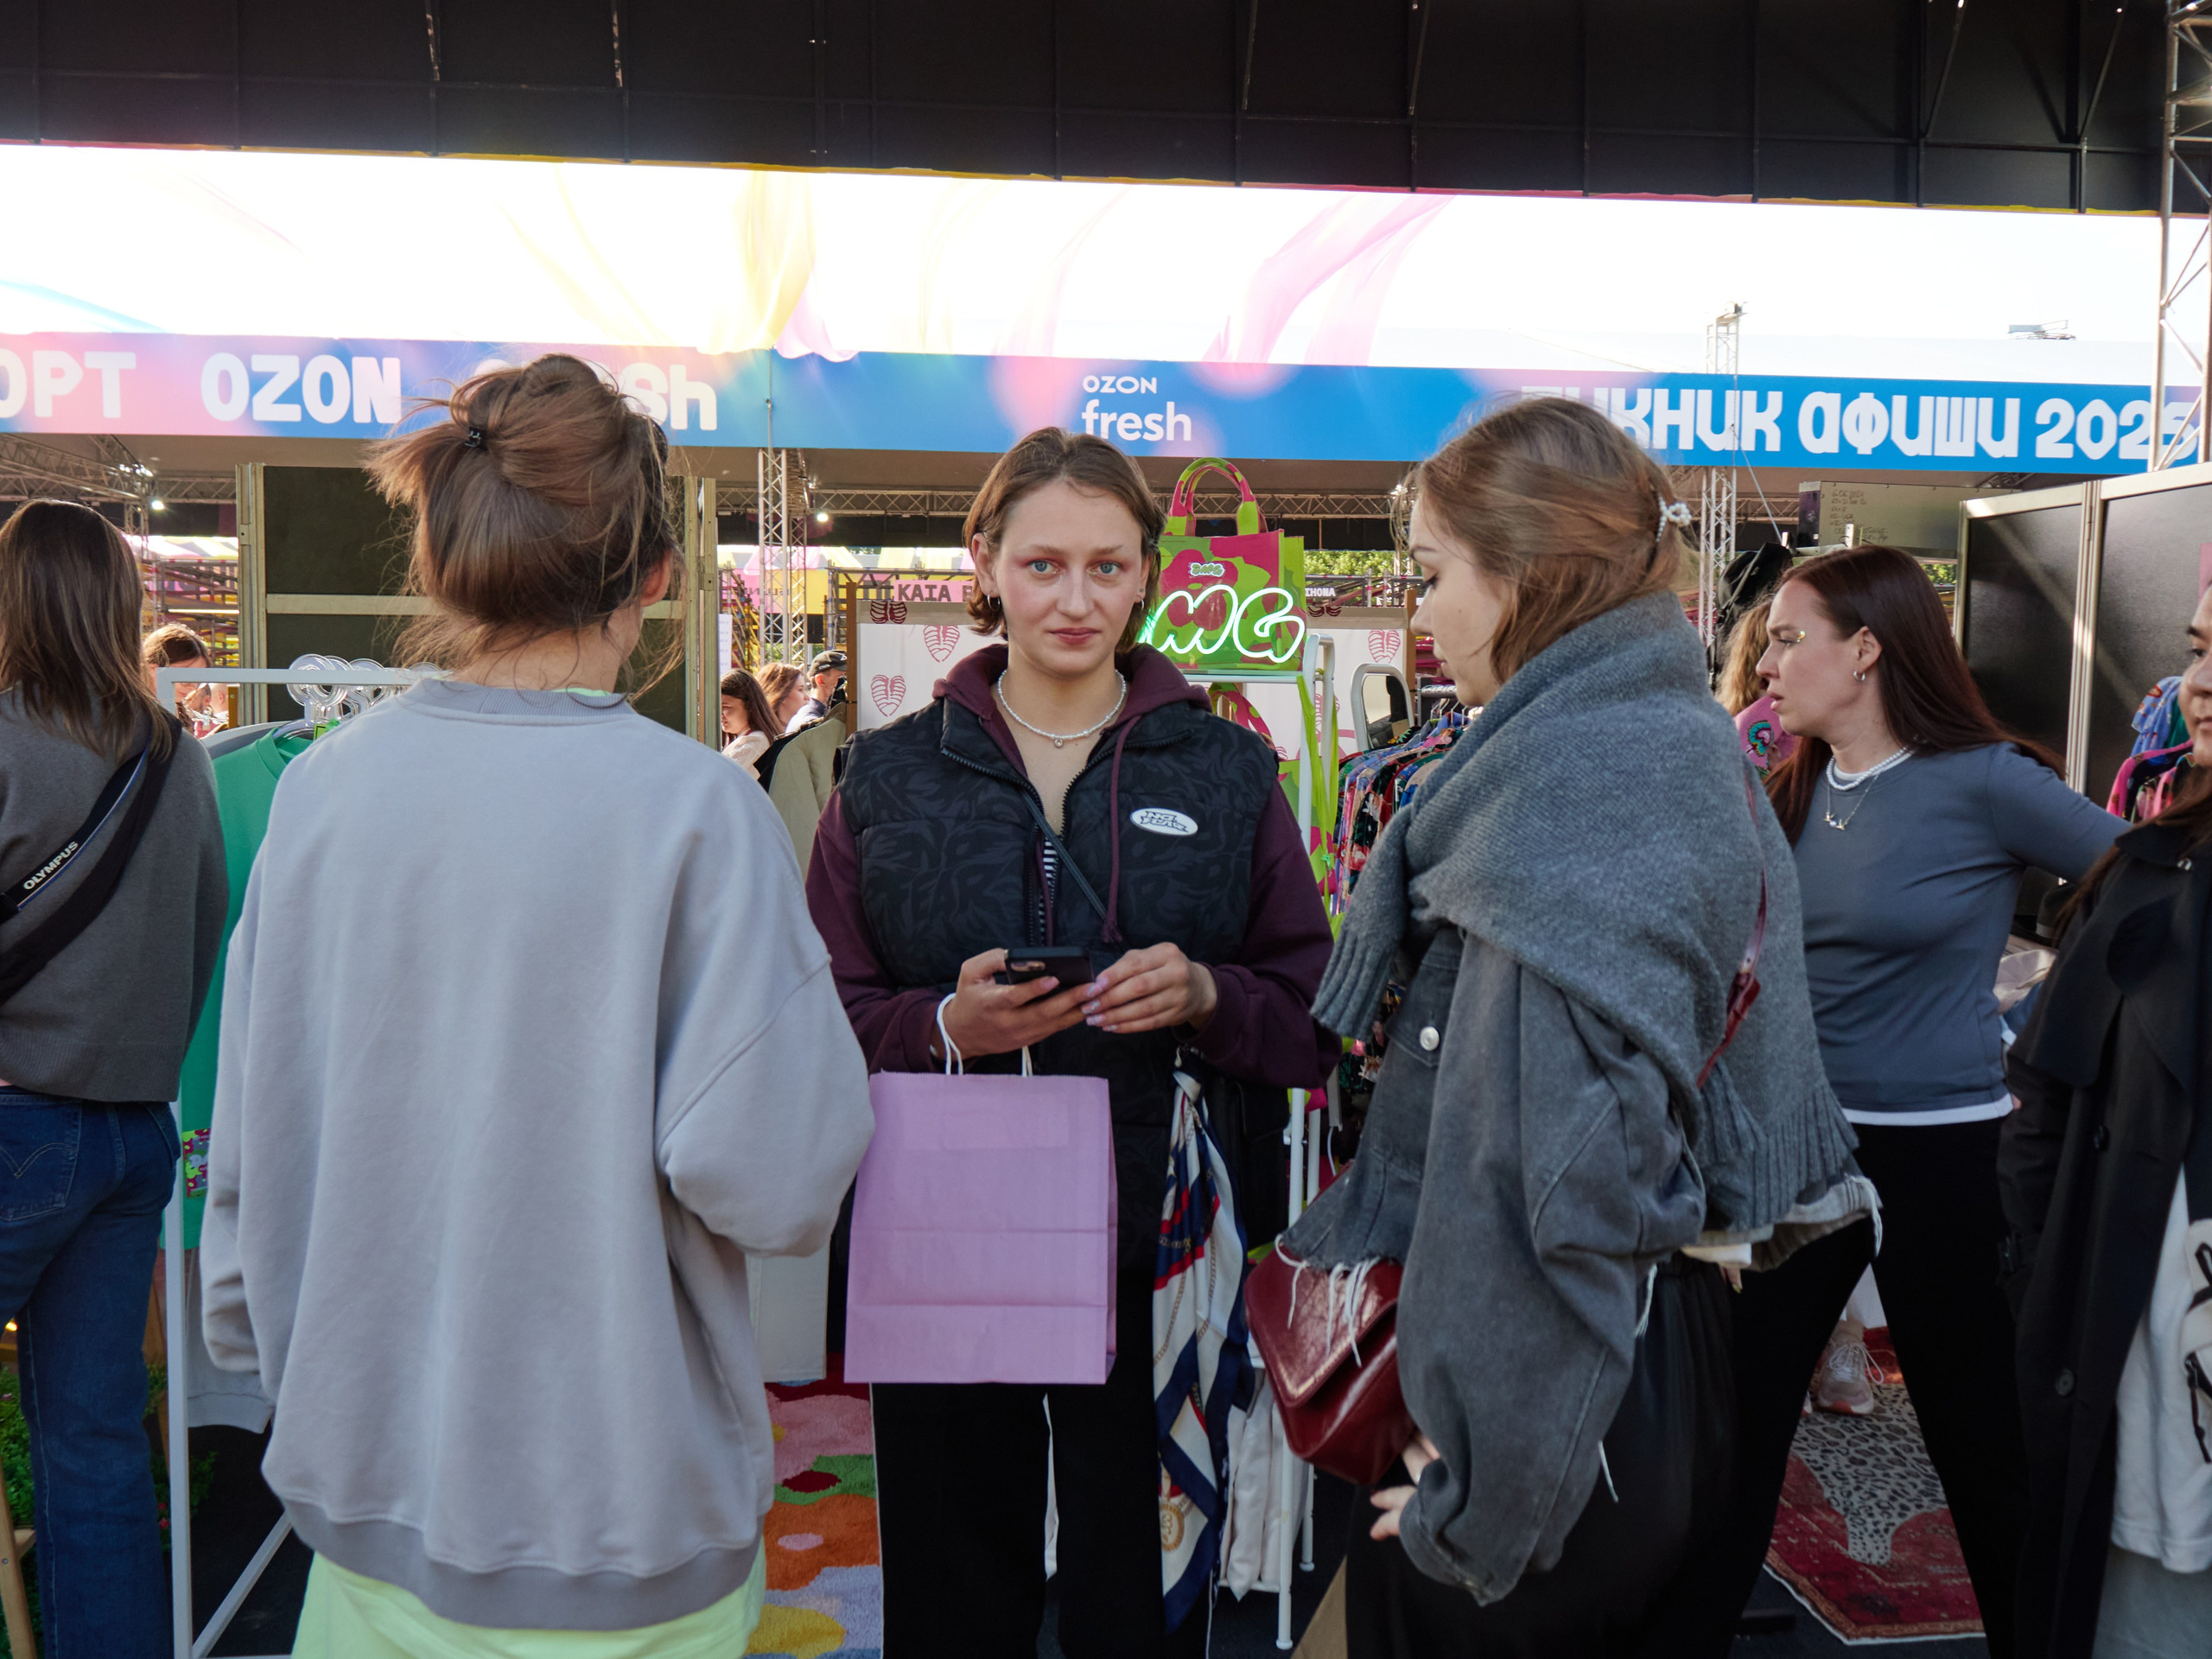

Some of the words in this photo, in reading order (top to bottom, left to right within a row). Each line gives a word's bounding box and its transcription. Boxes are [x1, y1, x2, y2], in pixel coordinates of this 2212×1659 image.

[200, 352, 402, 424] OZON
[1082, 375, 1158, 394] OZON
[1081, 398, 1192, 442] fresh
[1522, 385, 1783, 453] КНИК
[23, 841, 79, 890] OLYMPUS
